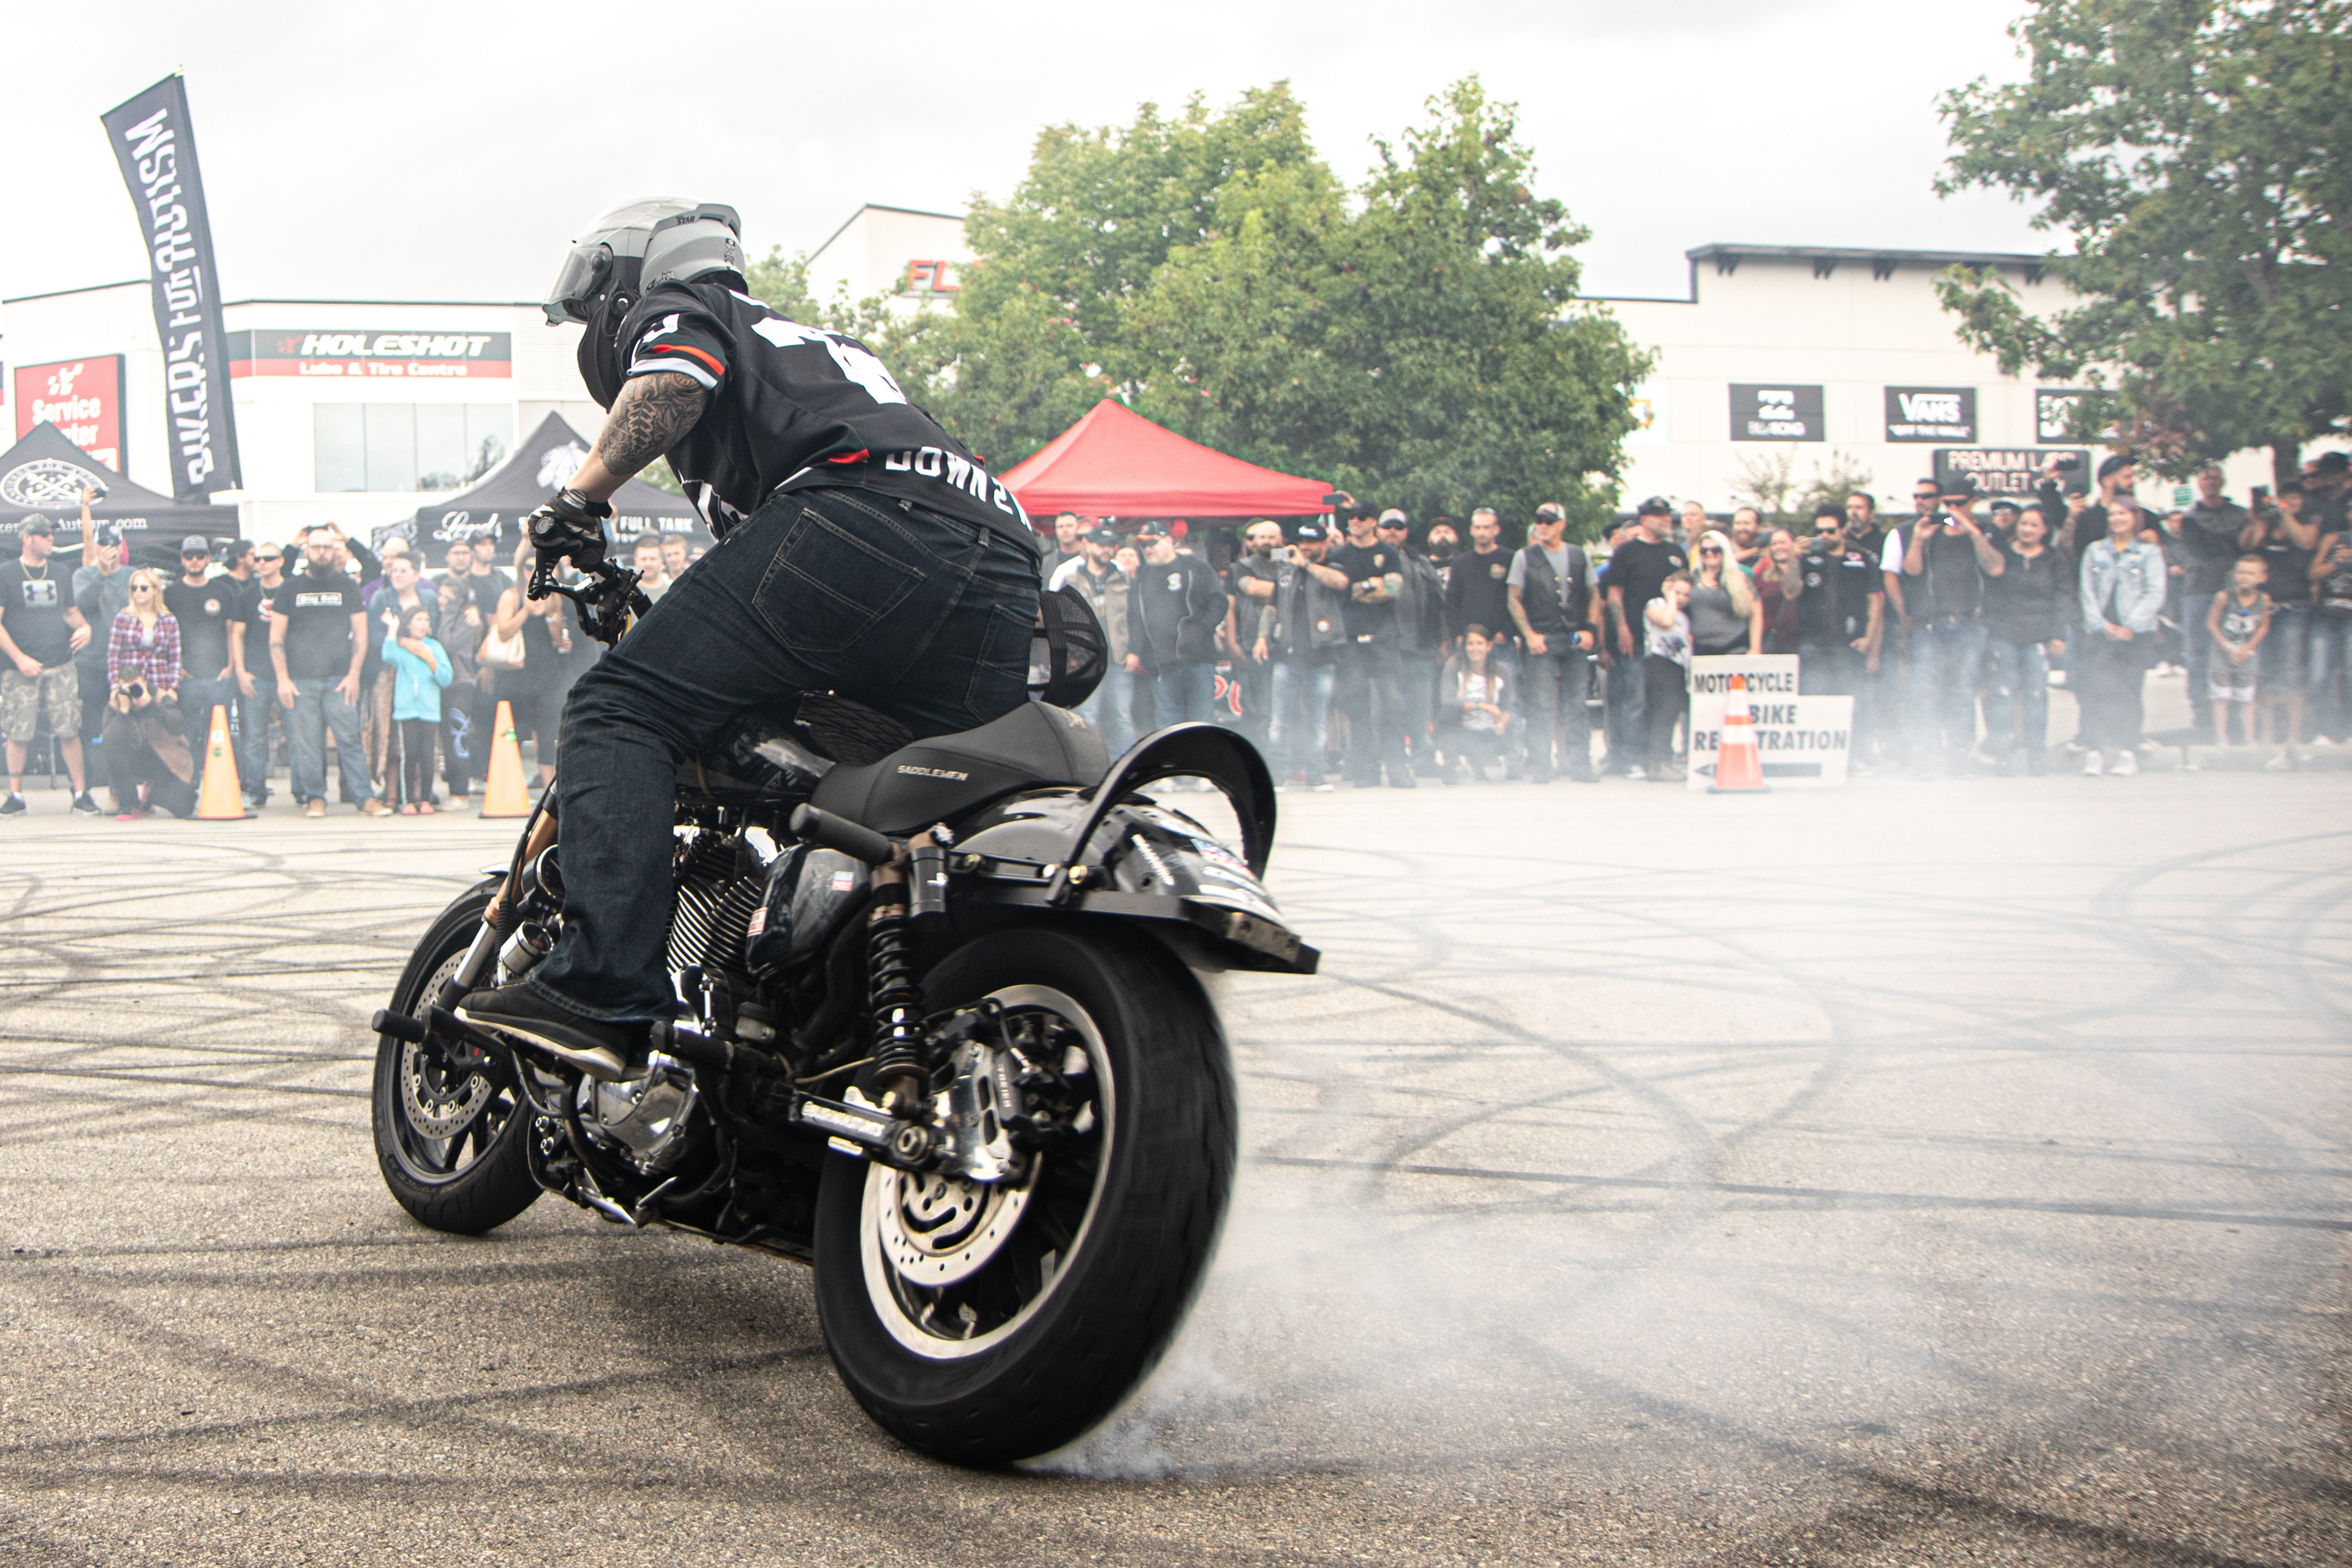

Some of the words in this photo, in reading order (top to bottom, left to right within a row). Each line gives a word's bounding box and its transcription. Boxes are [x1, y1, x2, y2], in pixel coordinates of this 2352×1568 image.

[124, 108, 196, 273] AUTISM
[676, 216, 695, 225] STAR
[300, 334, 491, 357] HOLESHOT
[300, 362, 343, 375] Lube
[347, 363, 363, 375] &
[368, 363, 403, 375] Tire
[407, 363, 467, 376] Centre
[32, 394, 101, 426] Service
[1898, 393, 1961, 423] VANS
[1948, 450, 2027, 471] PREMIUM
[658, 517, 693, 534] TANK
[1694, 673, 1794, 693] MOTCYCLE
[1749, 704, 1798, 724] BIKE
[1694, 730, 1847, 750] RETRATION
